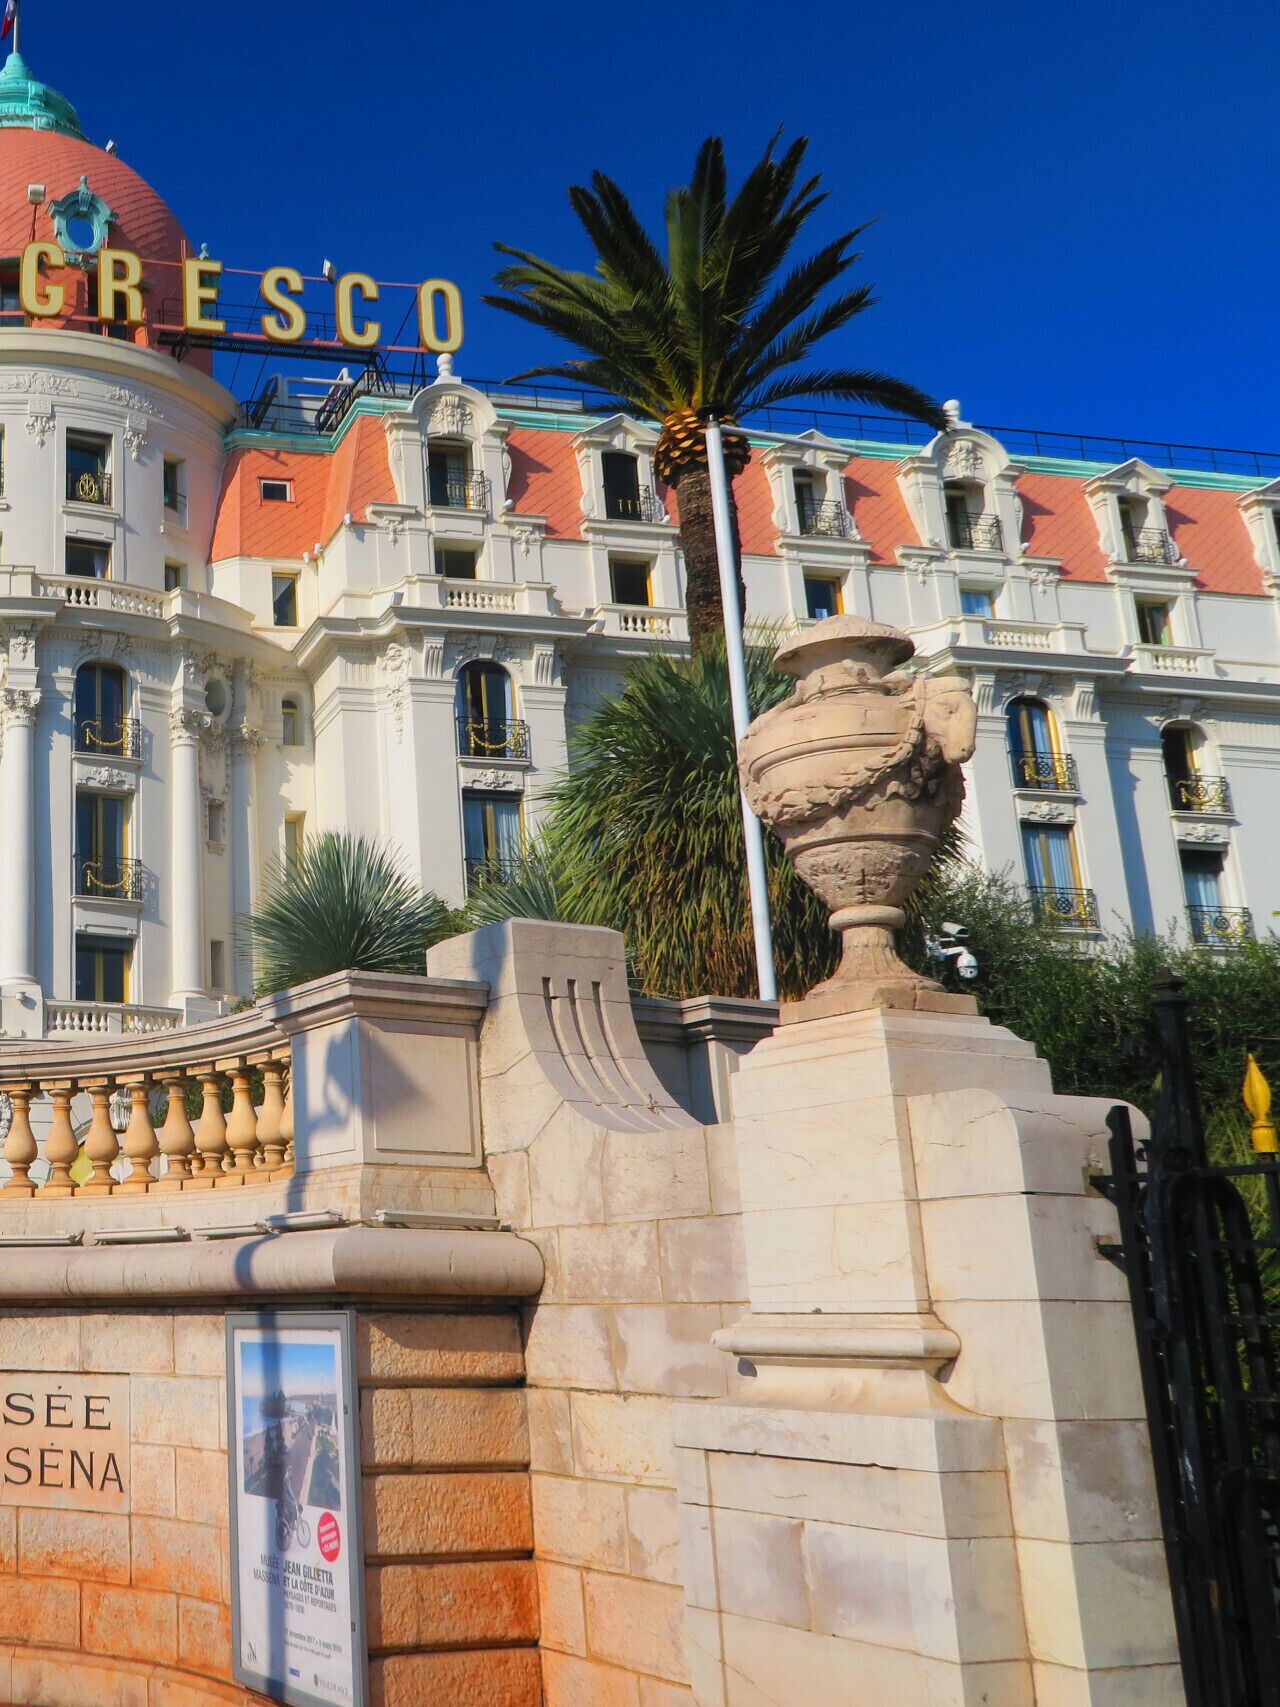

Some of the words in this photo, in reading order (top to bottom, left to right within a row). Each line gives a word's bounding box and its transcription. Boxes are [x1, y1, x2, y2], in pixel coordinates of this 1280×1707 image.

[283, 1559, 301, 1577] JEAN
[302, 1564, 334, 1586] GILLETTA
[283, 1575, 290, 1587] ET
[291, 1578, 299, 1591] LA
[300, 1578, 314, 1594] CÔTE
